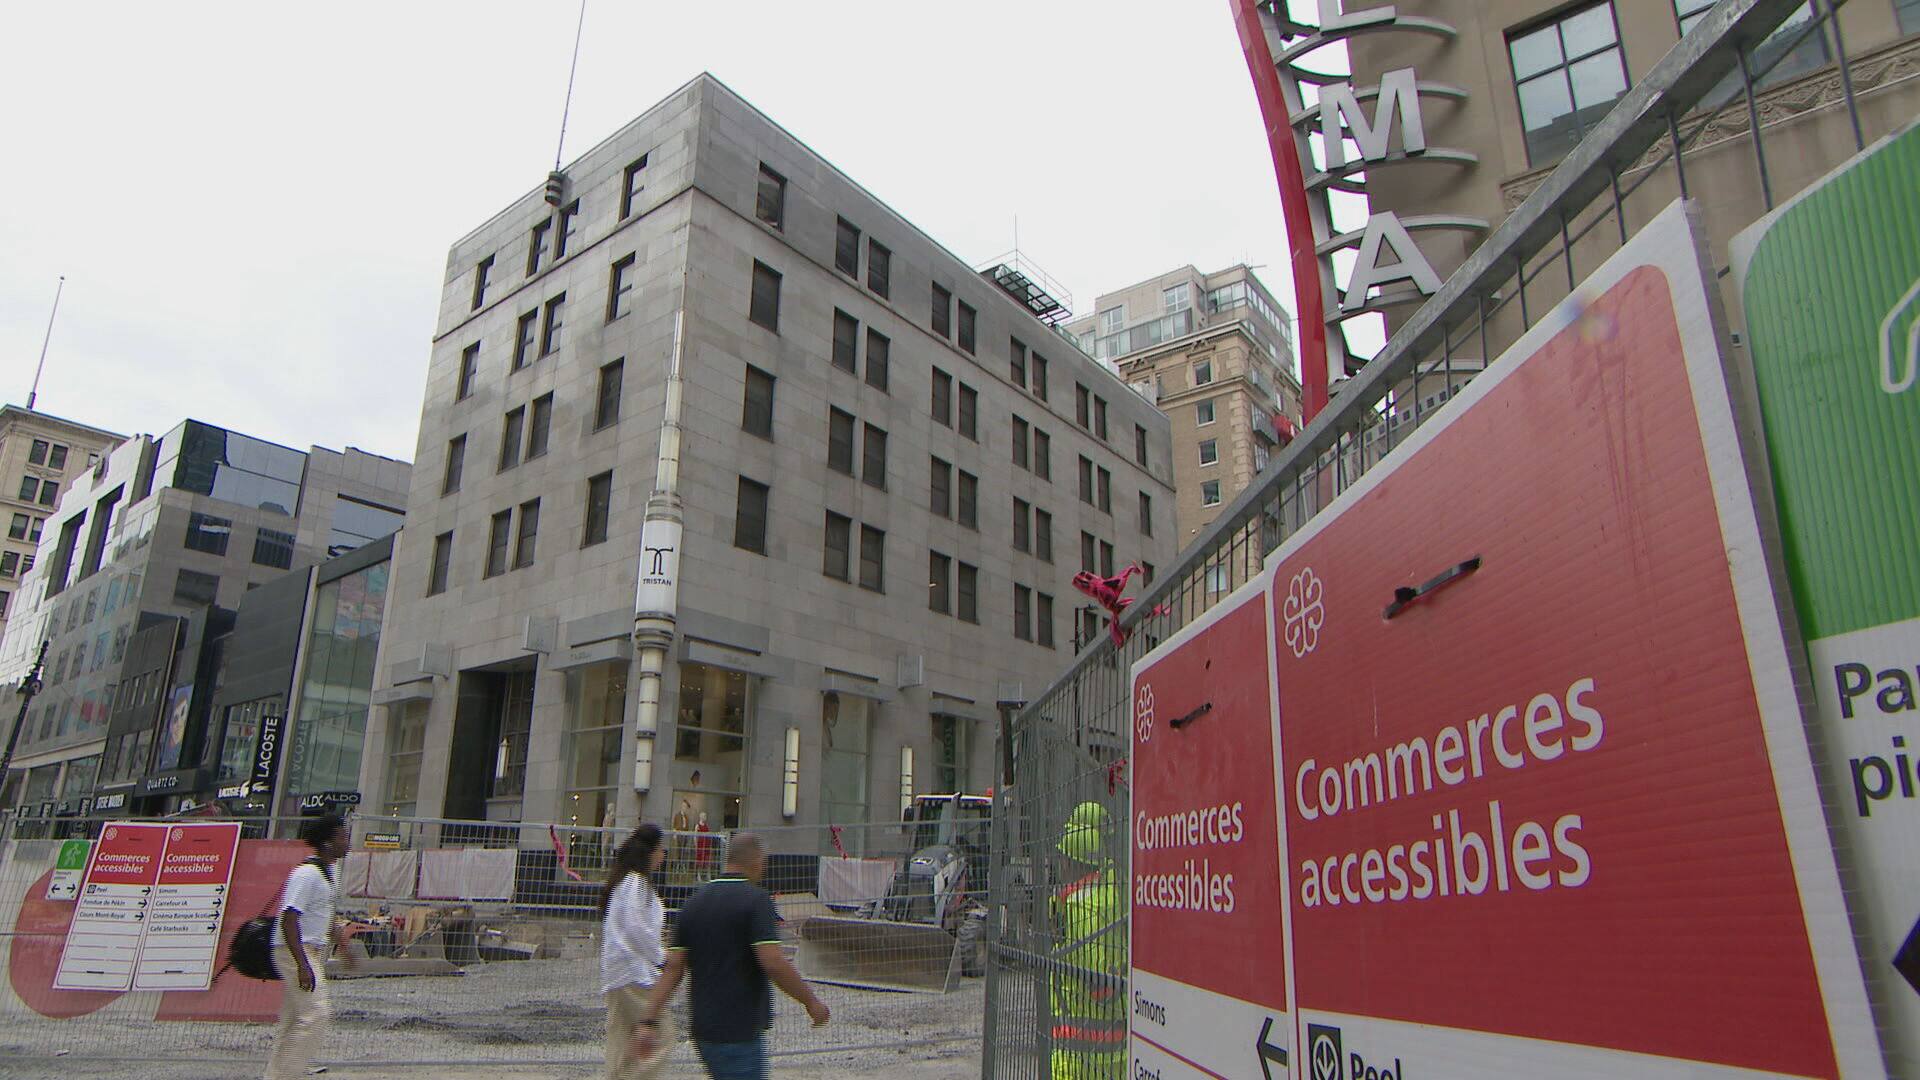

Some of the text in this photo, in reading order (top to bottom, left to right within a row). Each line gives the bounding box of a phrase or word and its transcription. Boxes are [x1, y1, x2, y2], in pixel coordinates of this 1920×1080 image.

[643, 578, 672, 586] TRISTAN
[1834, 662, 1920, 719] Pa
[257, 717, 278, 777] LACOSTE
[1295, 677, 1604, 820] Commerces
[1849, 735, 1920, 817] pi
[325, 793, 359, 802] ALDO
[1136, 801, 1243, 850] Commerces
[94, 863, 144, 873] accessibles
[98, 852, 151, 863] Commerces
[164, 863, 214, 873] accessibles
[167, 853, 220, 863] Commerces
[1300, 799, 1591, 908] accessibles
[1136, 858, 1235, 913] accessibles
[1134, 990, 1166, 1026] Simons
